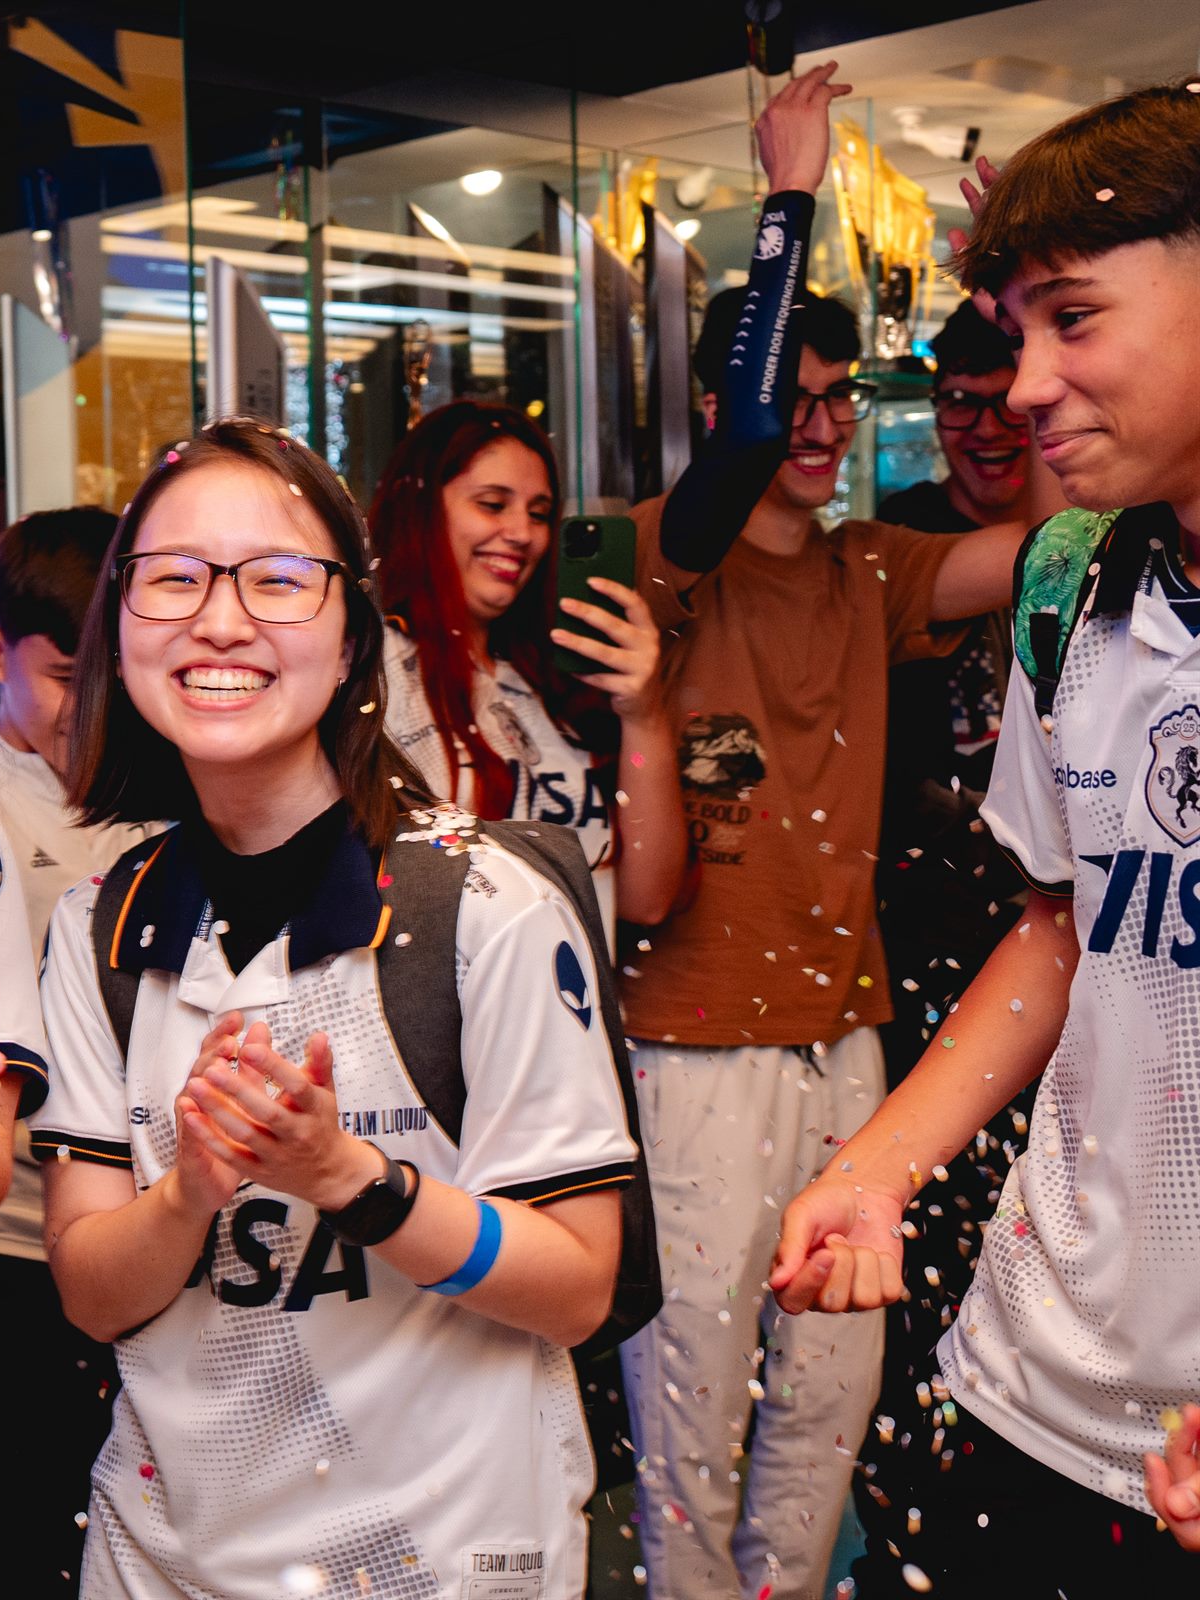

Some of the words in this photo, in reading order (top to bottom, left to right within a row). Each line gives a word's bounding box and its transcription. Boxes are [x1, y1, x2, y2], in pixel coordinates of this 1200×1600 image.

[788, 240, 802, 277] PASSOS
[775, 278, 797, 331] PEQUENOS
[769, 331, 785, 354] DOS
[762, 355, 780, 393] PODER
[338, 1110, 377, 1137] EAM
[381, 1106, 428, 1137] LIQUID
[471, 1553, 506, 1573] TEAM
[509, 1551, 543, 1574] LIQUID
